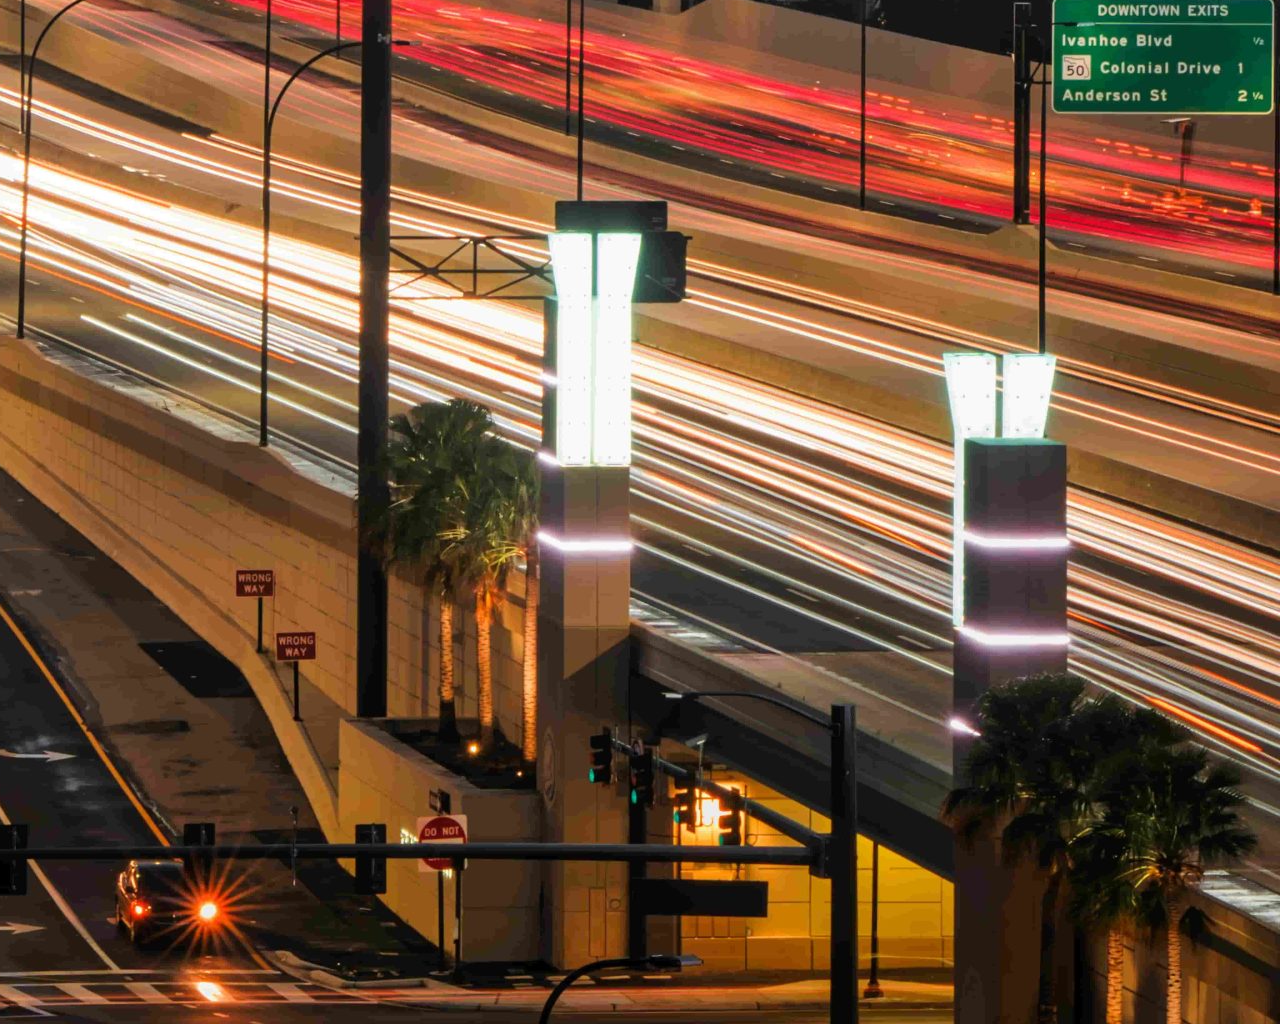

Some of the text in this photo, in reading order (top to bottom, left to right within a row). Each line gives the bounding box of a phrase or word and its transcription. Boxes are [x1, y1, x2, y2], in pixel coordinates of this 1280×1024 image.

[1098, 4, 1229, 17] DOWNTOWN EXITS
[1062, 34, 1128, 47] Ivanhoe
[1136, 34, 1172, 47] Blvd
[1066, 61, 1243, 76] 50 Colonial Drive 1
[1062, 89, 1141, 101] Anderson
[1150, 89, 1168, 101] St
[1237, 90, 1248, 101] 2
[238, 573, 271, 582] WRONG
[244, 585, 264, 593] WAY
[278, 636, 314, 646] WRONG
[285, 647, 307, 657] WAY
[424, 828, 437, 837] DO
[442, 826, 459, 836] NOT
